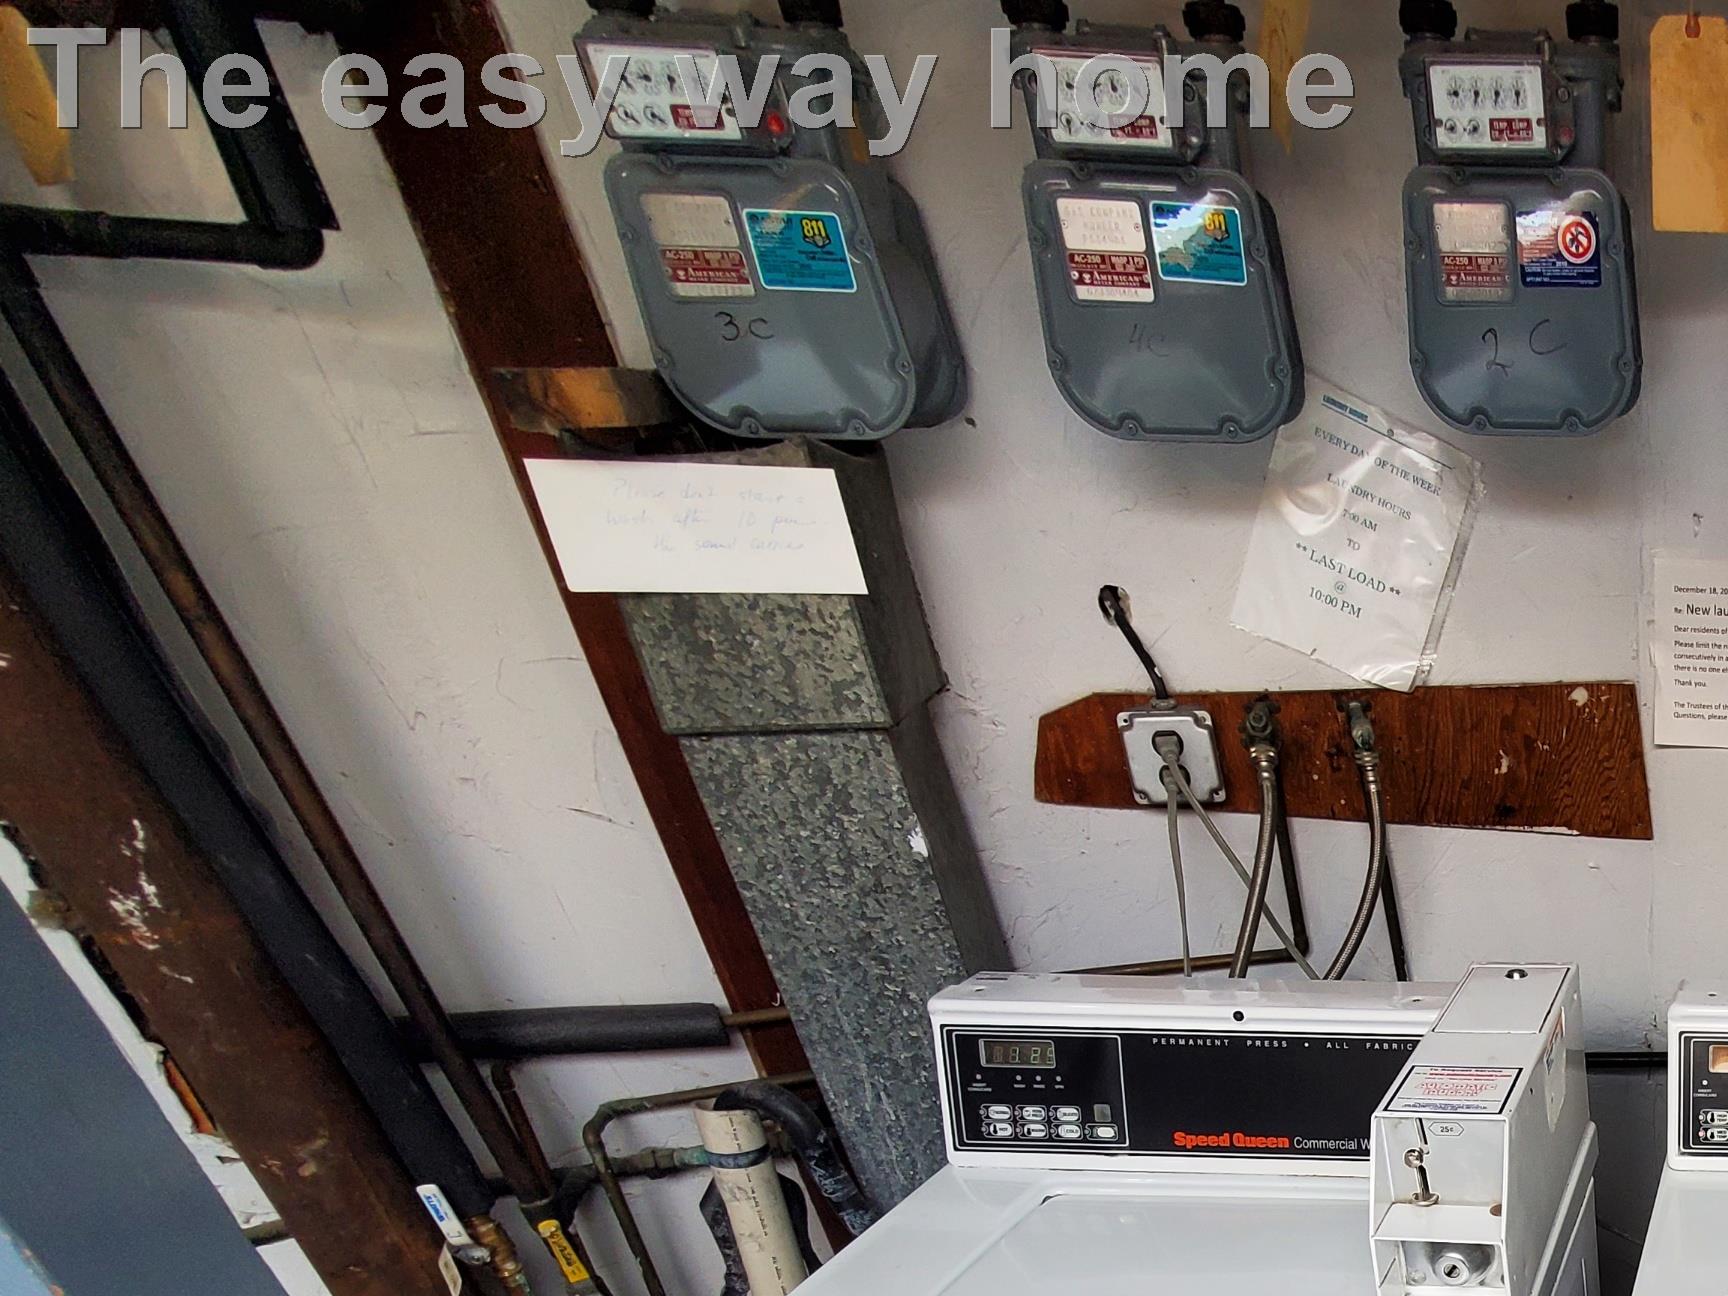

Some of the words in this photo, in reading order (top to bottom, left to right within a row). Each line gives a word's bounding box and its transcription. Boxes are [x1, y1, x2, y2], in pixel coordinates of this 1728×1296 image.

[1204, 211, 1226, 231] 811
[801, 218, 826, 238] 811
[1073, 254, 1101, 264] AC-250
[1444, 257, 1468, 265] AC-250
[688, 267, 738, 278] AMERICAN
[1094, 271, 1139, 281] AMERICAN
[1314, 426, 1350, 451] EVERY
[1374, 457, 1389, 470] OF
[1390, 465, 1411, 481] THE
[1412, 476, 1442, 496] WEEK
[1378, 497, 1412, 521] HOURS
[1360, 519, 1378, 532] AM
[1309, 549, 1346, 575] LAST
[1347, 567, 1386, 594] LOAD
[1334, 580, 1347, 594] @
[1674, 585, 1707, 594] December
[1709, 586, 1719, 595] 18,
[1309, 586, 1338, 609] 10:00
[1340, 600, 1362, 619] PM
[1686, 603, 1710, 616] New
[1674, 625, 1690, 633] Dear
[1690, 626, 1719, 635] residents
[1721, 627, 1728, 635] of
[1674, 640, 1694, 648] Please
[1696, 641, 1710, 649] limit
[1711, 642, 1722, 650] the
[1674, 653, 1716, 662] consecutively
[1674, 664, 1691, 672] there
[1674, 679, 1693, 687] Thank
[1674, 701, 1685, 709] The
[1687, 702, 1713, 710] Trustees
[1673, 711, 1706, 720] Questions,
[1708, 713, 1728, 721] please
[1152, 1038, 1230, 1047] PERMANENT
[1246, 1040, 1288, 1048] PRESS
[1326, 1042, 1349, 1050] ALL
[1366, 1043, 1414, 1051] FABRIC
[1173, 1131, 1230, 1149] Speed
[1233, 1132, 1290, 1149] Queen
[1293, 1137, 1357, 1150] Commercial
